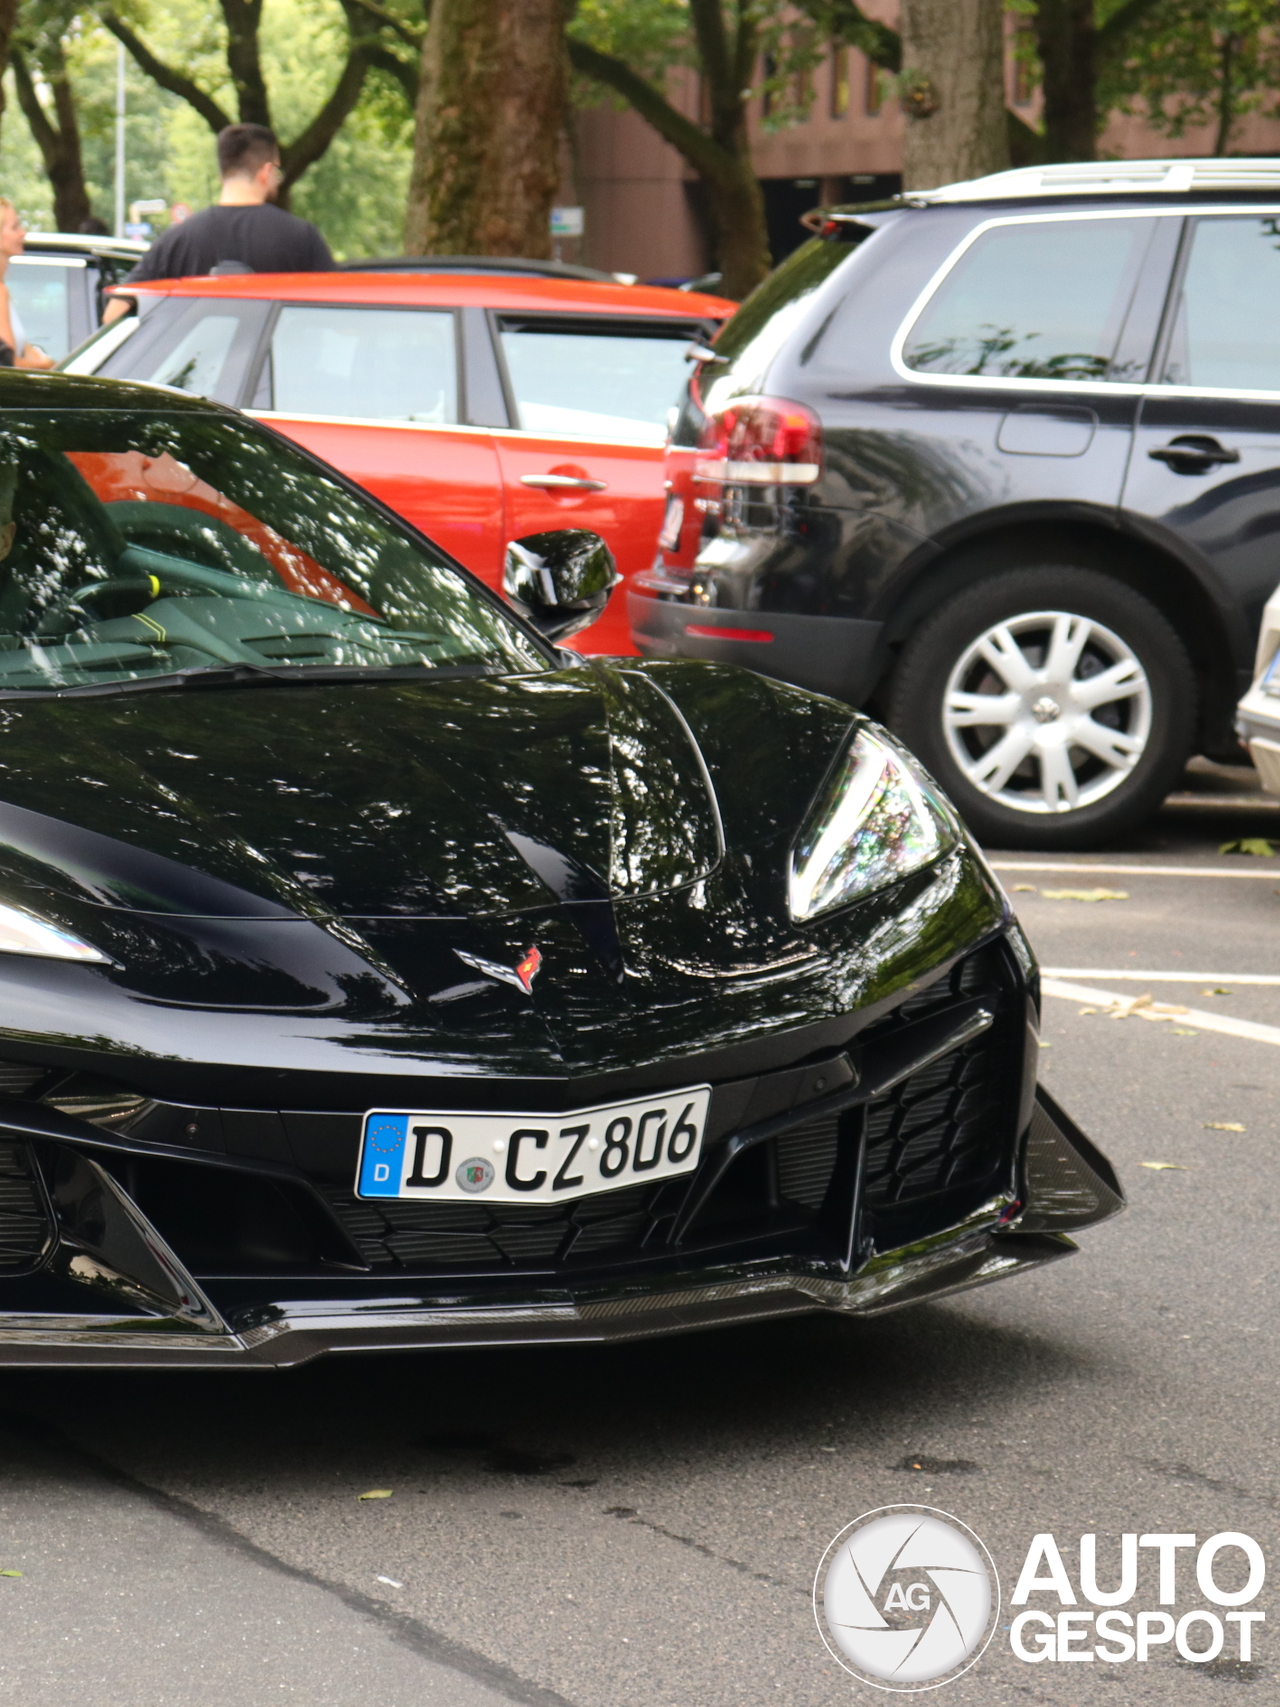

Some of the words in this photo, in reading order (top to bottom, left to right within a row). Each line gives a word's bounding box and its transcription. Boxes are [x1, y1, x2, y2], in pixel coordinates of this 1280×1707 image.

[373, 1164, 389, 1182] D
[406, 1125, 453, 1188] D
[505, 1123, 591, 1192] CZ
[599, 1102, 697, 1179] 806
